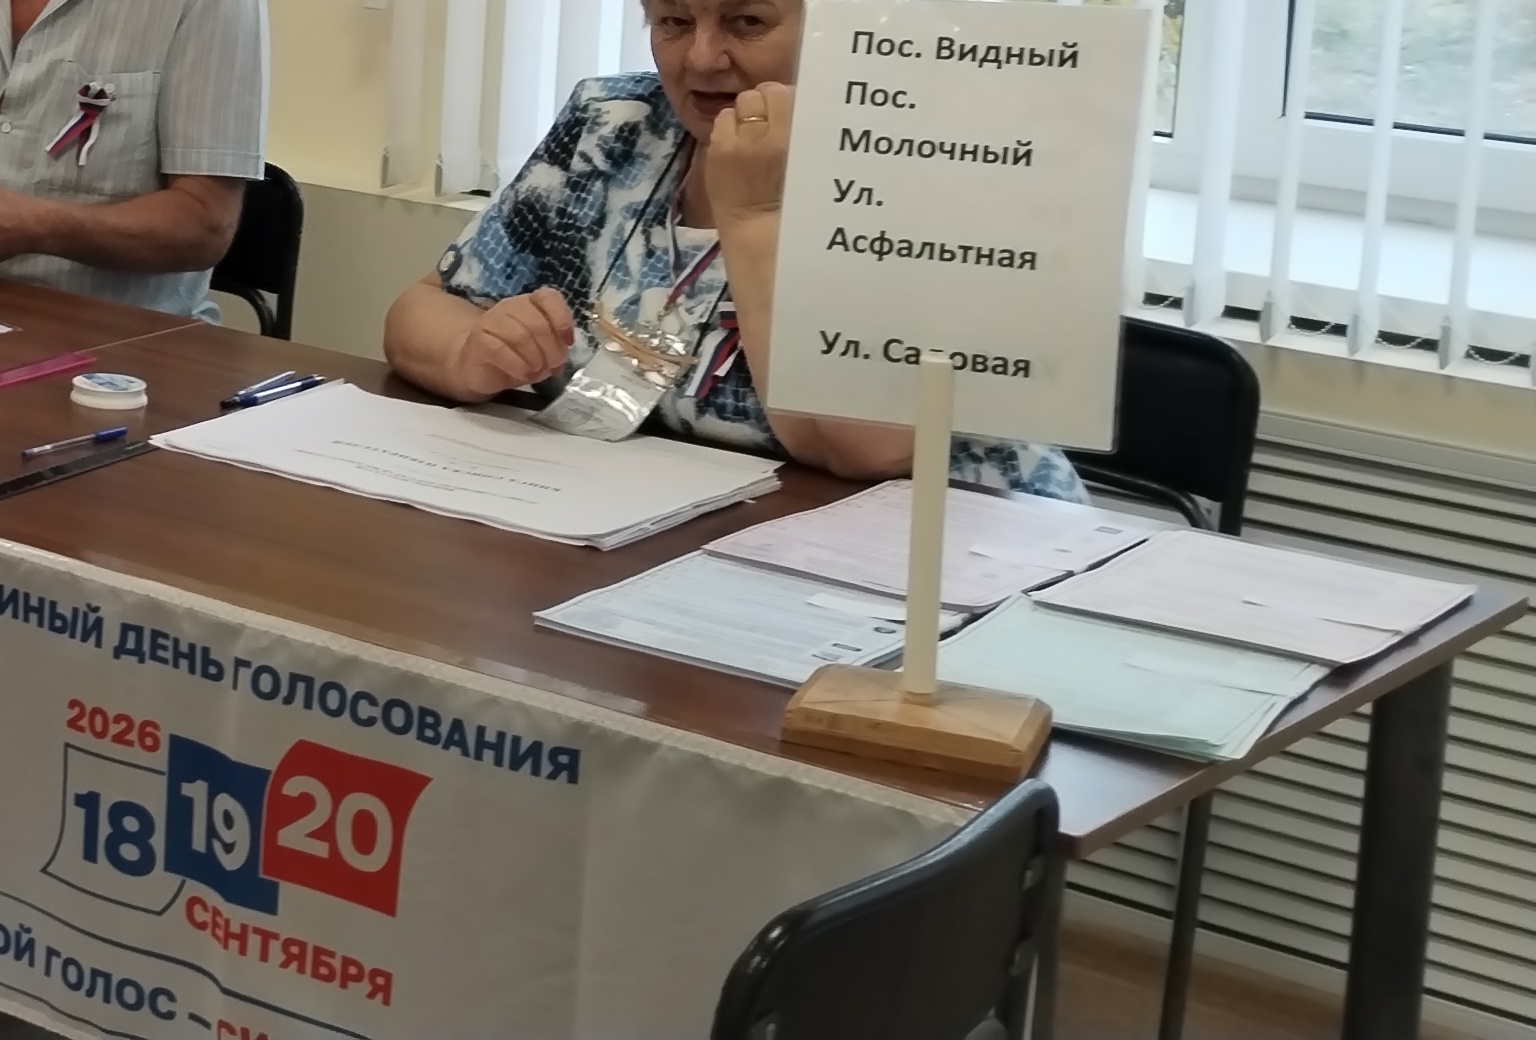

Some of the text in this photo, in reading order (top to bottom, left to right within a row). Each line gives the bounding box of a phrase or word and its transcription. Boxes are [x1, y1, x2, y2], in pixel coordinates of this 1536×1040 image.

[851, 30, 1079, 69] Пос. Видный
[844, 80, 917, 110] Пос.
[838, 127, 1034, 167] Молочный
[832, 178, 885, 207] Ул.
[826, 226, 1038, 271] Асфальтная
[819, 329, 1031, 378] Ул. Саовая
[65, 698, 162, 753] 2026
[112, 621, 226, 683] ДЕНЬ
[231, 655, 582, 785] ГОЛОСОВАНИЯ
[72, 789, 157, 877] 18
[180, 778, 252, 871] 19
[276, 775, 394, 873] 20
[184, 894, 394, 1007] СЕНТЯБРЯ
[43, 944, 178, 1021] ГОЛОС
